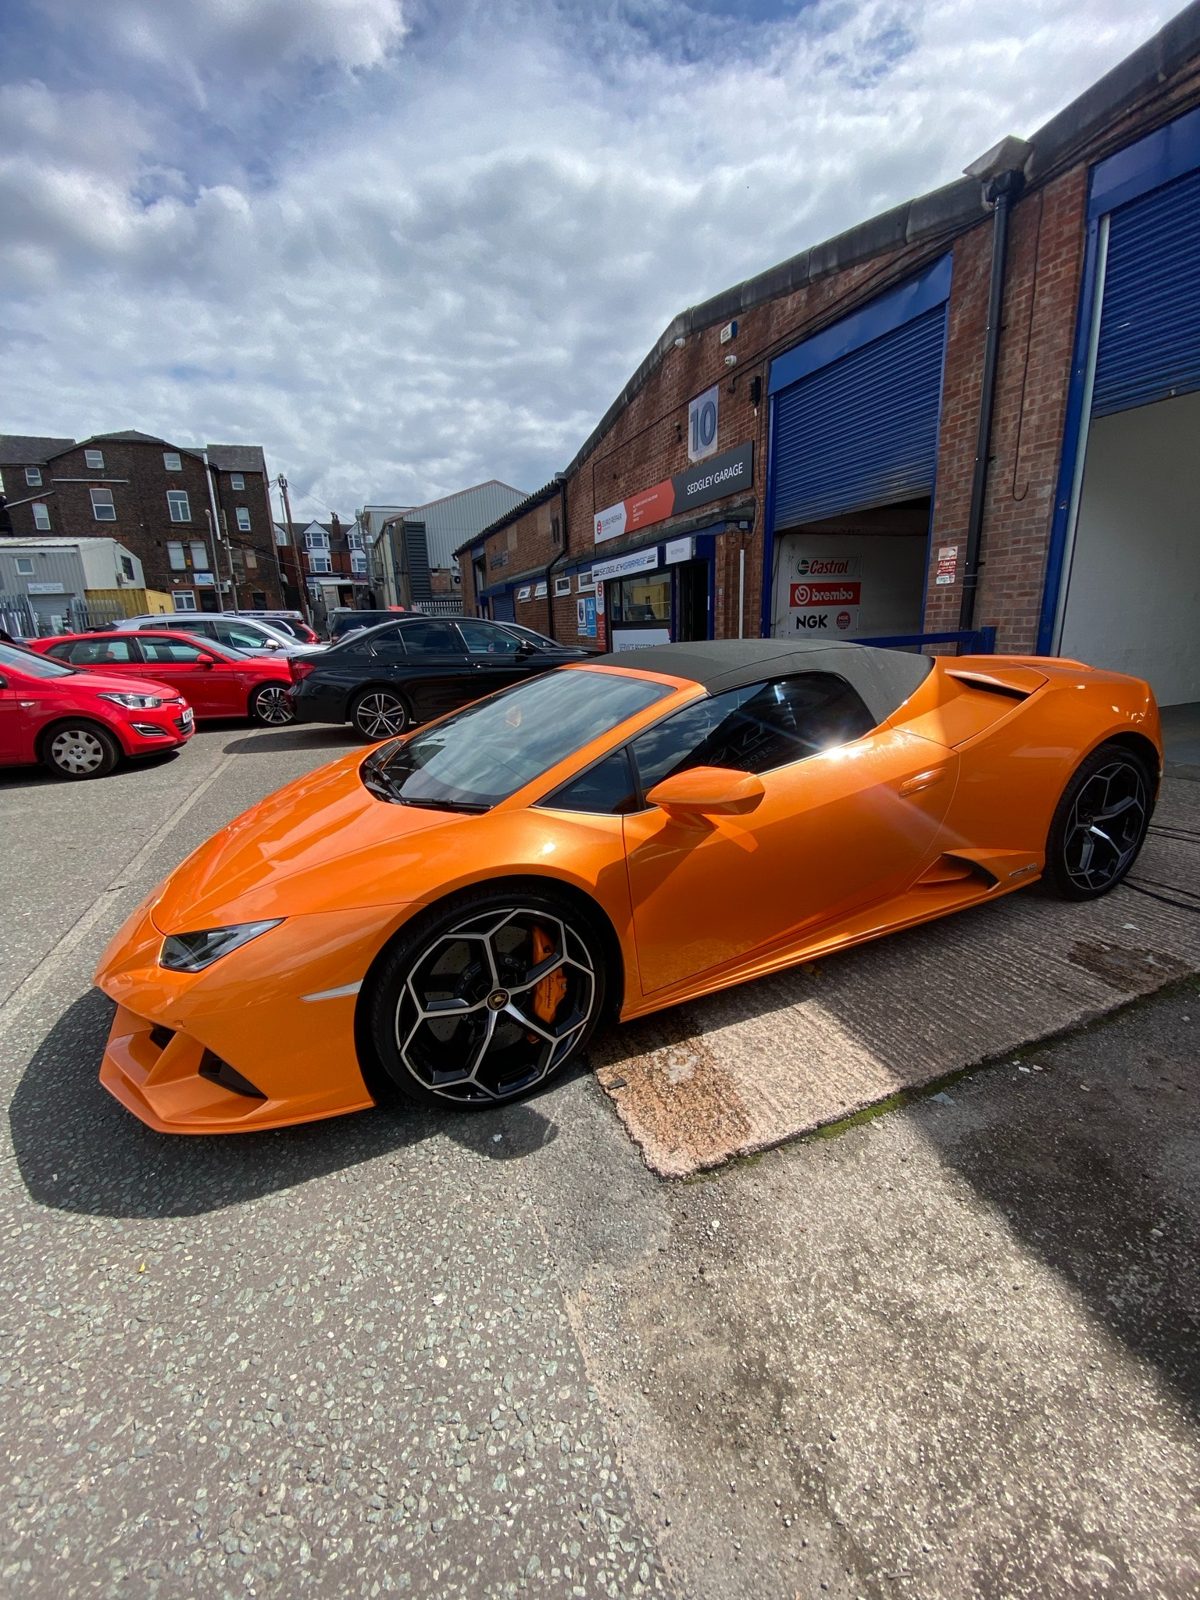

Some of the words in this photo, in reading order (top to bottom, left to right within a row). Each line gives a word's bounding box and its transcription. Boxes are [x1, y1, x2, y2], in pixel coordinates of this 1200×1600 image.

[690, 401, 716, 452] 10
[687, 475, 714, 495] SEDGLEY
[714, 462, 743, 483] GARAGE
[810, 560, 849, 574] Castrol
[812, 588, 853, 601] brembo
[796, 614, 828, 629] NGK
